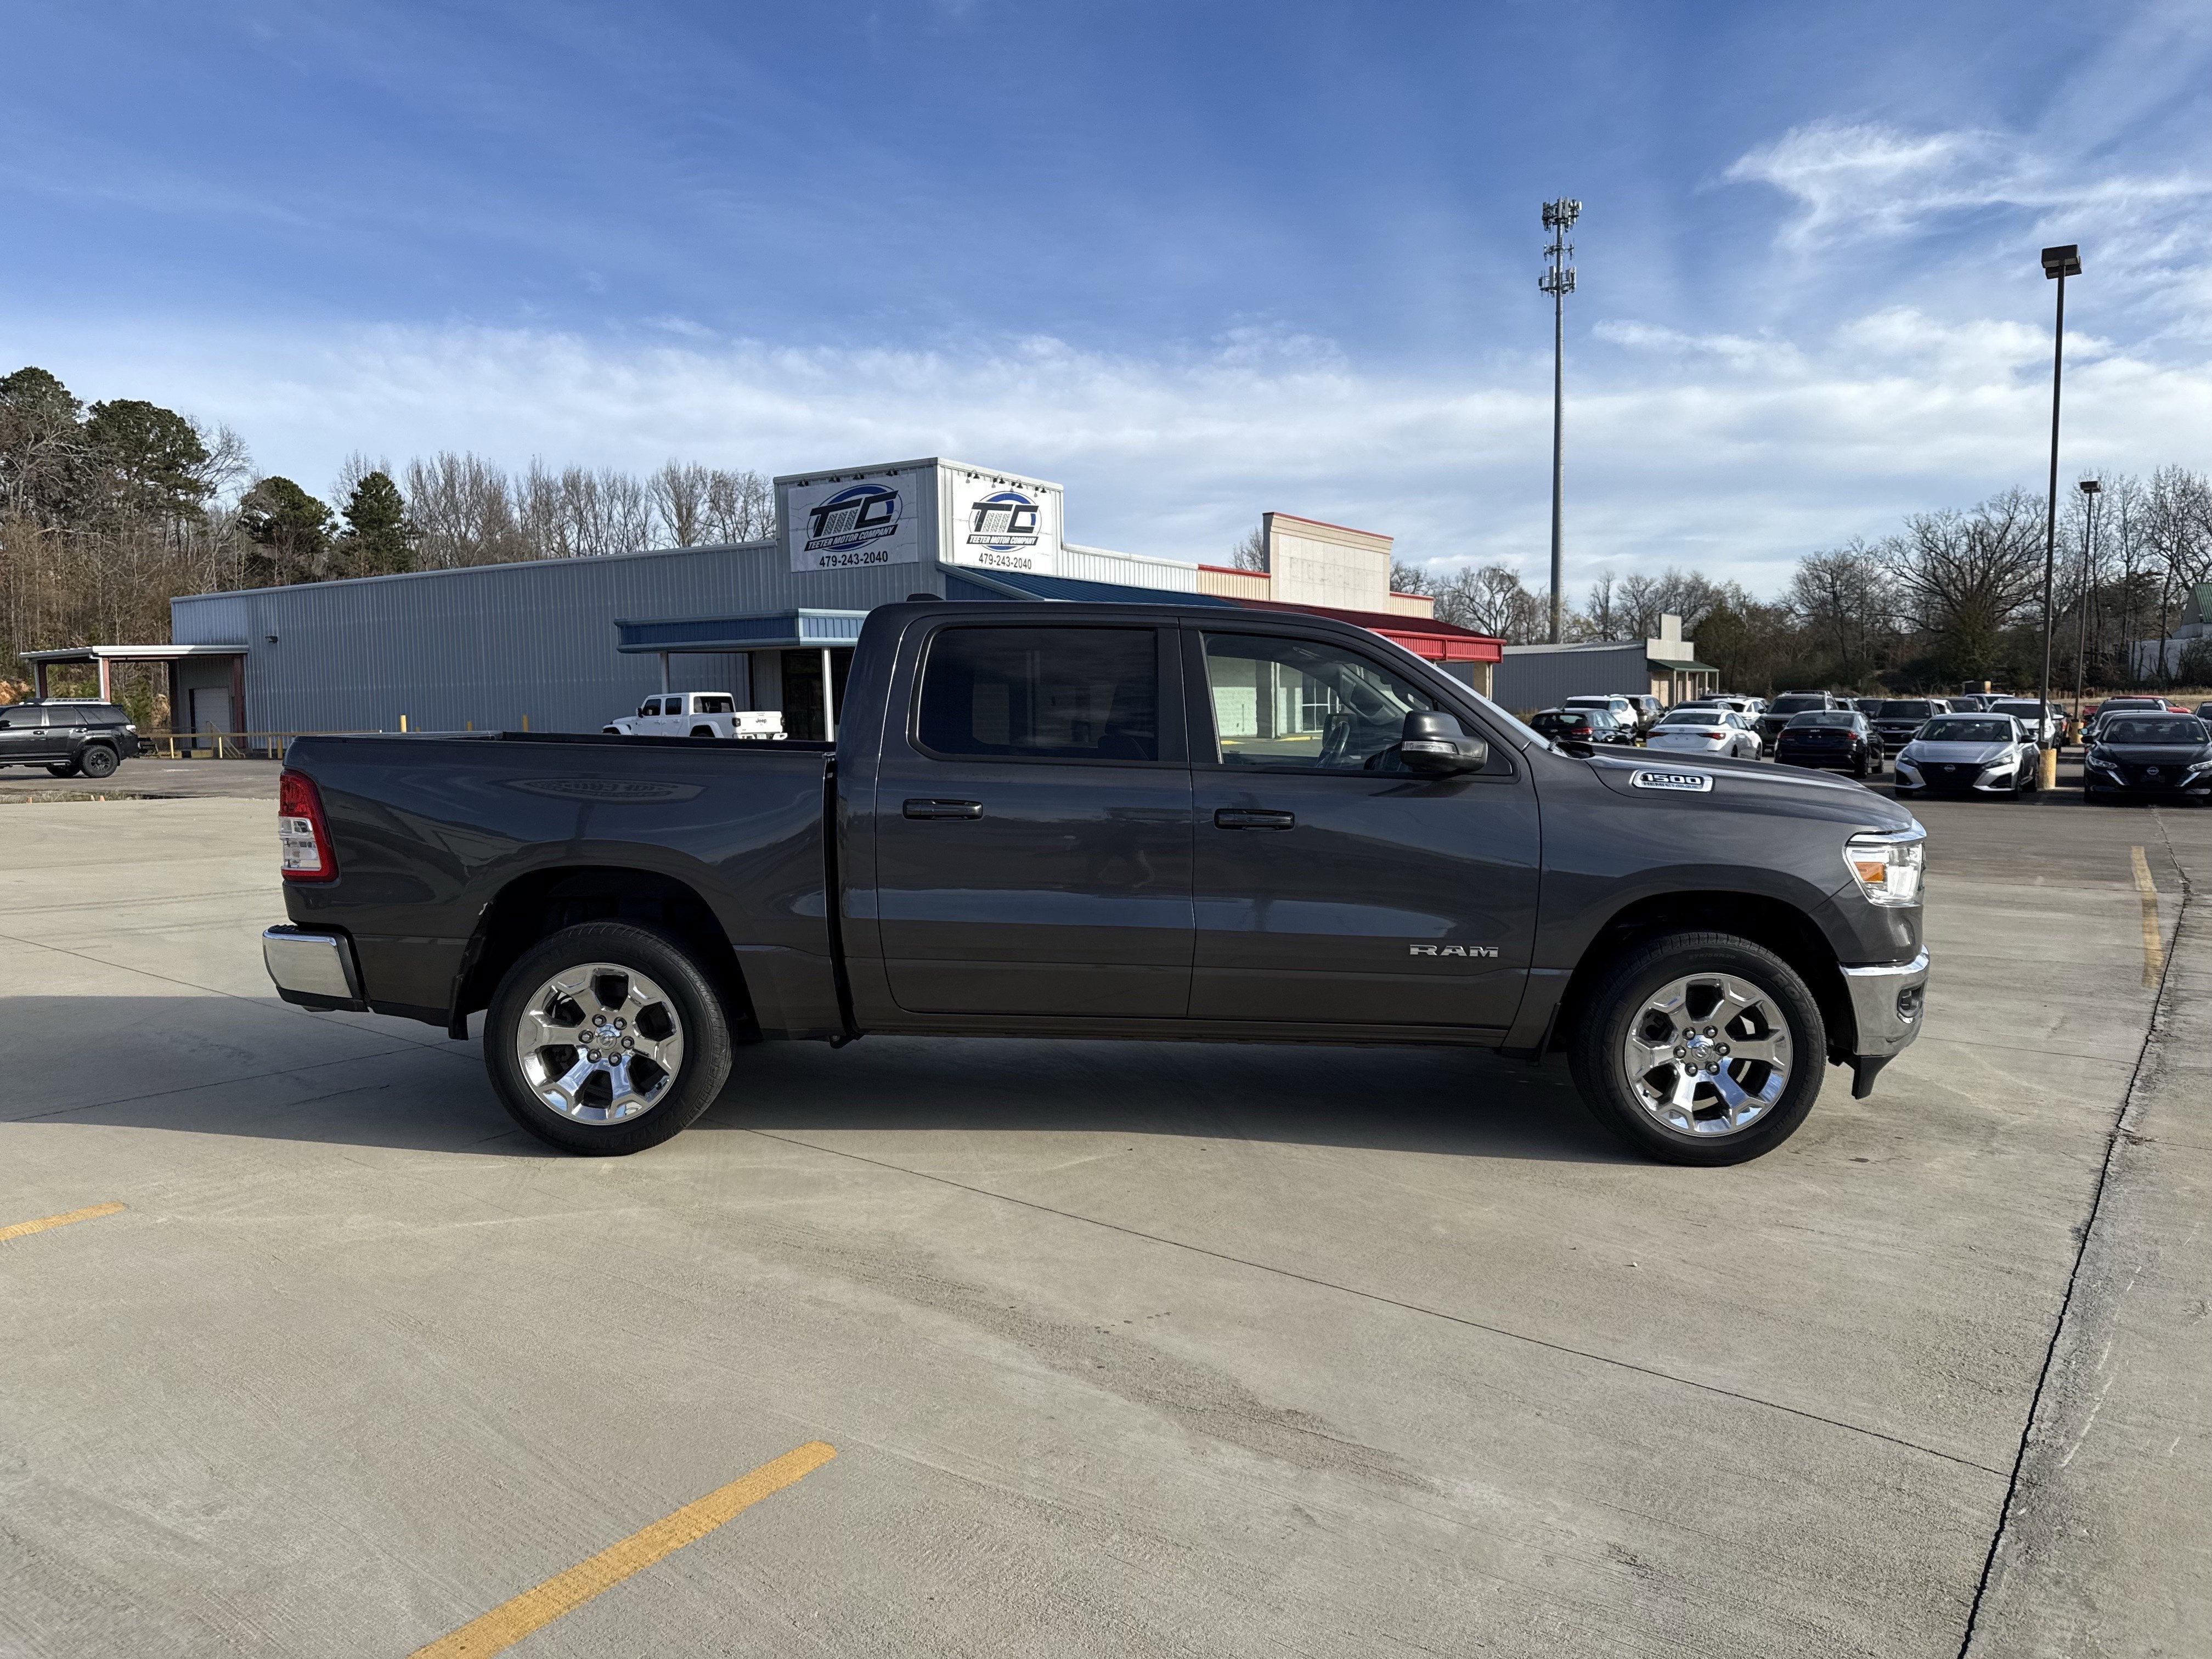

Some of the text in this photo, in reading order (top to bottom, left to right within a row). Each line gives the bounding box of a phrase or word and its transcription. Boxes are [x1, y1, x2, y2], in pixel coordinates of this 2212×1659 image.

[808, 526, 894, 550] TEETER MOTOR COMPANY
[969, 535, 1037, 545] TEETER MOTOR COMPANY
[819, 551, 888, 567] 479-243-2040
[979, 552, 1032, 570] 479-243-2040
[1640, 774, 1701, 785] 1500
[1410, 944, 1499, 958] RAM
